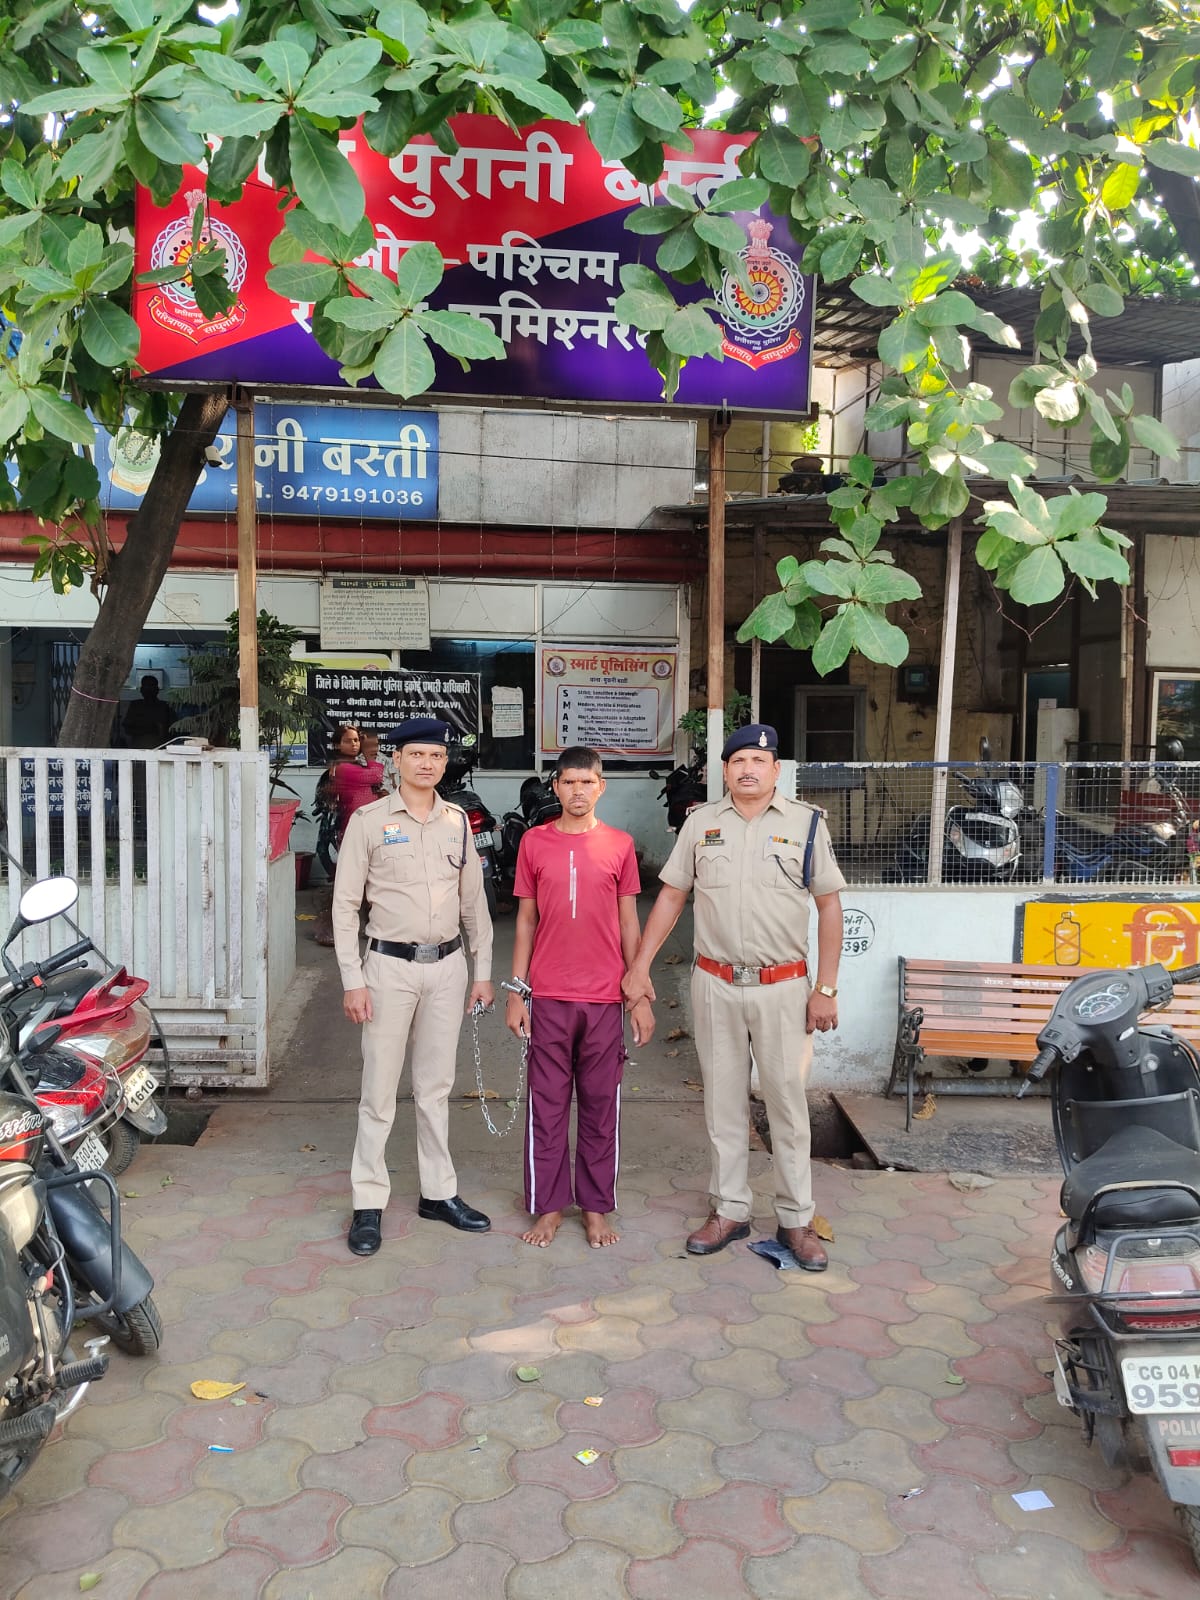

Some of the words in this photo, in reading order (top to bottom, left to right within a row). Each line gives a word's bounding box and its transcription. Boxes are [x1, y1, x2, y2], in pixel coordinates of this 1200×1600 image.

[388, 131, 574, 218] पुरानी
[466, 230, 620, 286] पश्चिम
[320, 423, 431, 479] बस्ती
[281, 483, 424, 506] 9479191036
[569, 656, 598, 671] स्मार्ट
[600, 657, 649, 675] पूलिसिंग
[315, 674, 333, 690] जिले
[333, 675, 340, 690] के
[341, 675, 360, 691] विशेष
[383, 676, 403, 696] पुलिस
[422, 678, 441, 693] प्रभारी
[442, 679, 470, 694] अधिकारी
[326, 698, 340, 706] नाम
[563, 701, 571, 709] M
[562, 713, 569, 721] A
[562, 725, 569, 733] R
[562, 736, 568, 744] T
[130, 1079, 155, 1106] 1610
[1138, 1366, 1163, 1380] CG
[1167, 1365, 1190, 1380] 04
